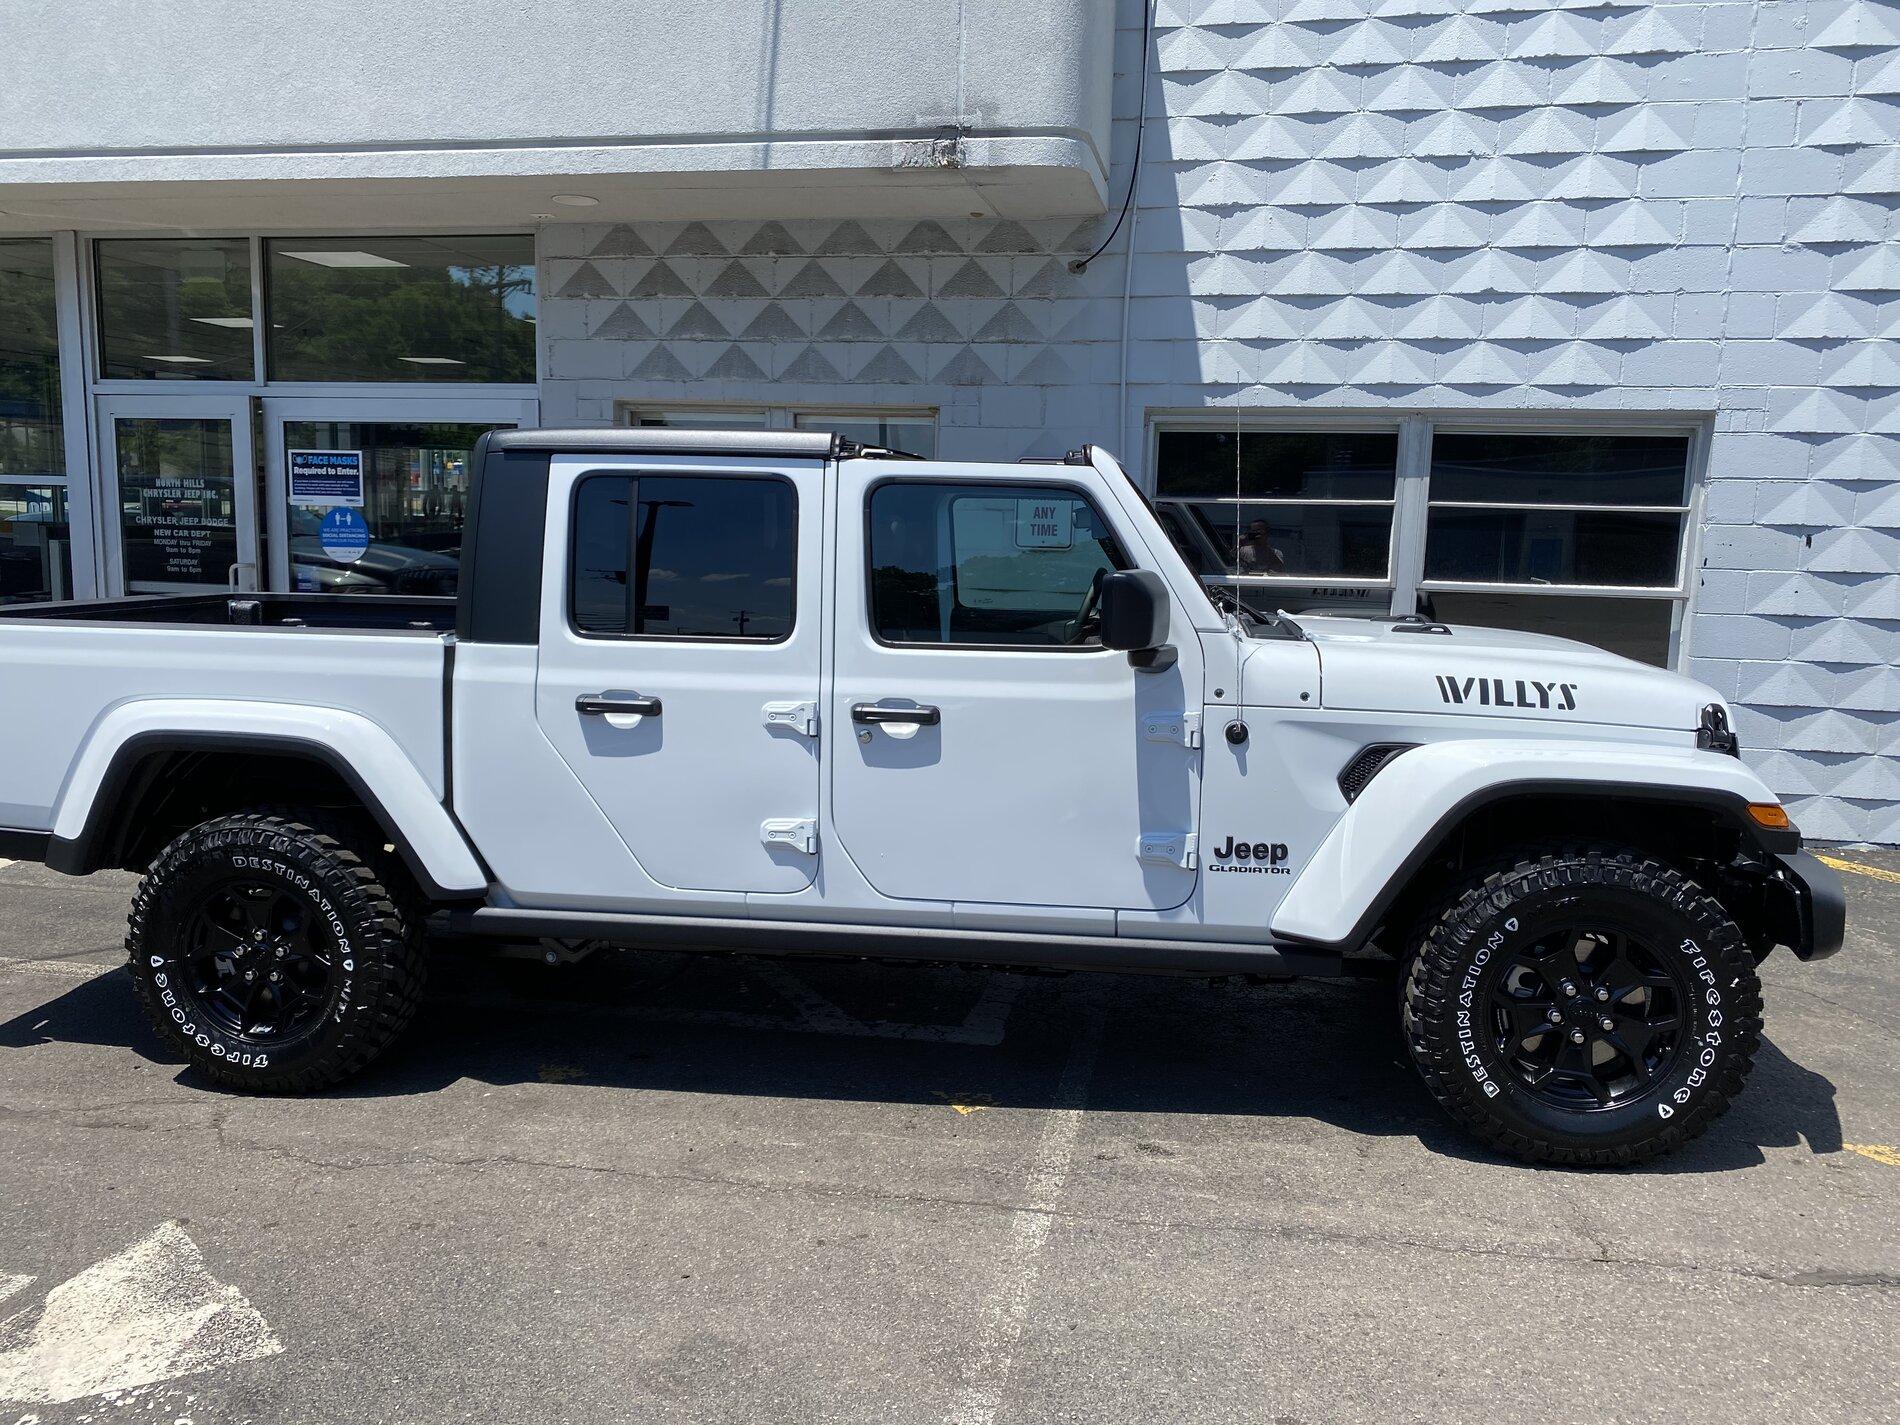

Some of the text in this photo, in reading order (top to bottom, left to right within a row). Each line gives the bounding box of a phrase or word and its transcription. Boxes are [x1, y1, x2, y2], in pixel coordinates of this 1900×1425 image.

[308, 456, 358, 465] FACE MASKS
[294, 466, 326, 476] Required
[337, 468, 359, 476] Enter.
[156, 478, 204, 488] NORTH HILLS
[143, 488, 219, 499] CHRYSLER JEEP INC.
[1033, 506, 1056, 520] ANY
[136, 516, 229, 527] CHRYSLER JEEP DODGE
[190, 530, 212, 538] DEPT
[1030, 523, 1058, 536] TIME
[1435, 675, 1578, 711] WILLYS
[1214, 836, 1288, 865] Jeep
[1208, 864, 1291, 874] GLADIATOR
[232, 856, 350, 953] DESTINATION
[1456, 931, 1504, 1099] DESTINATION
